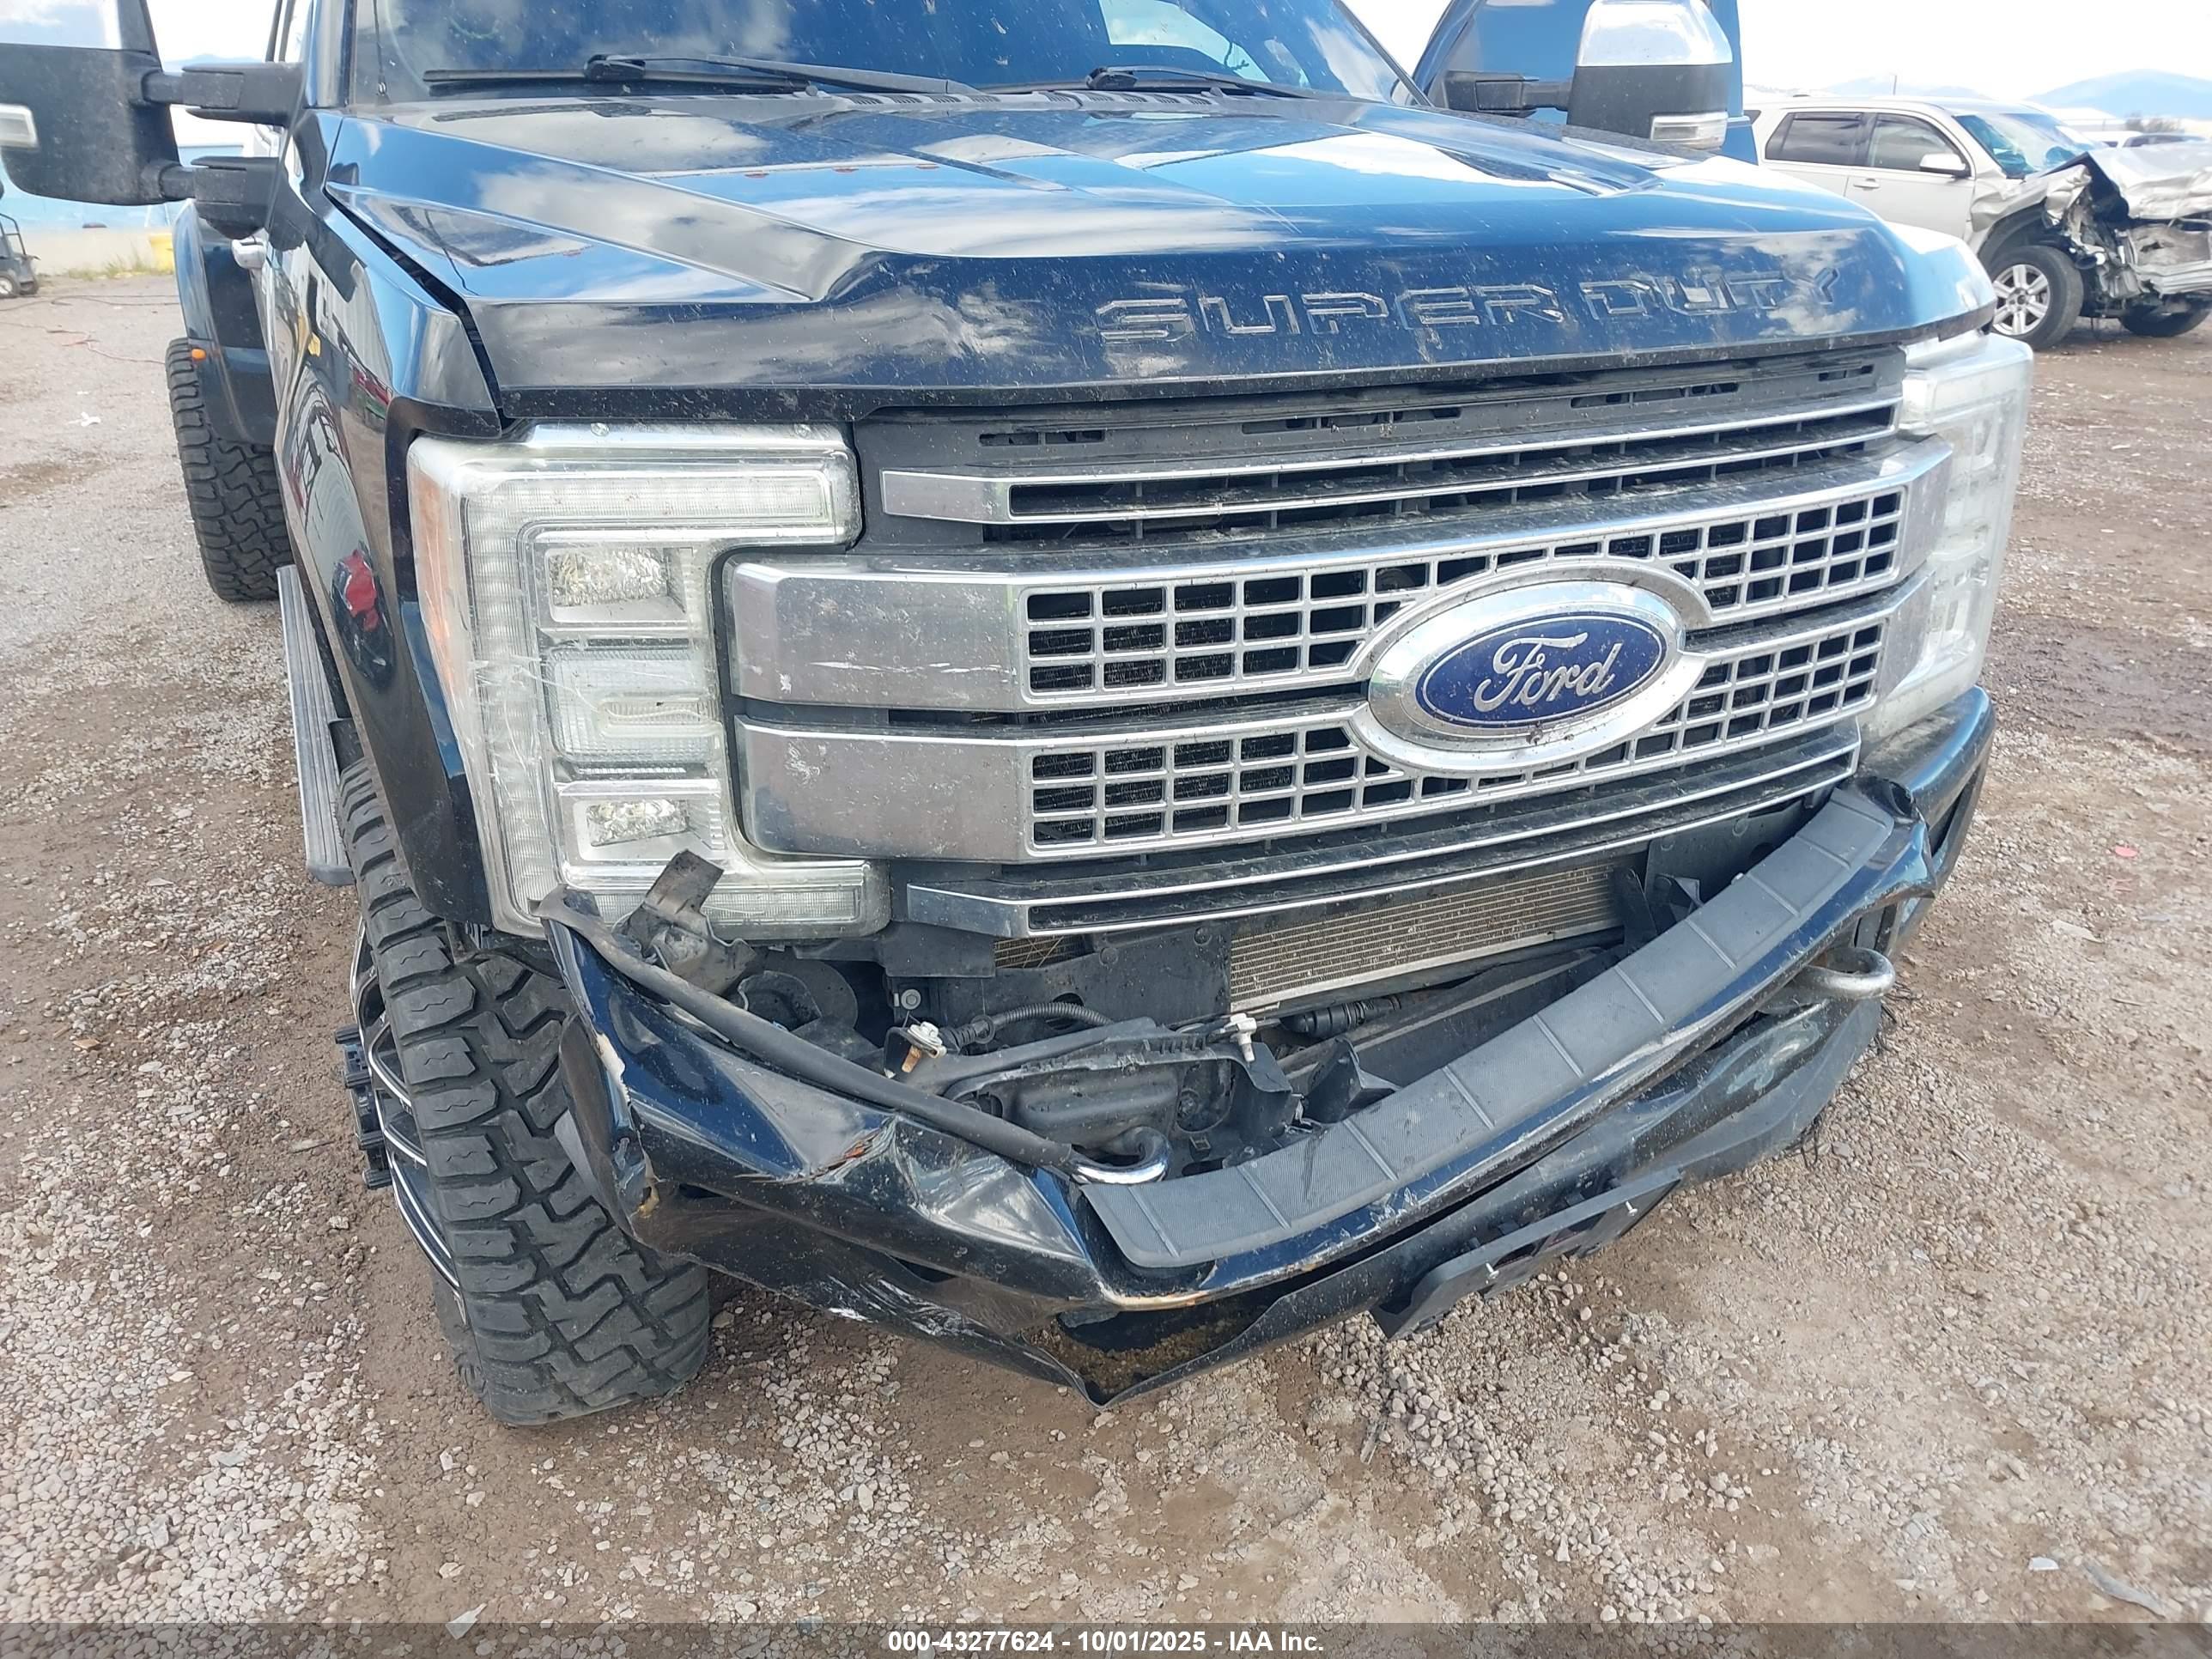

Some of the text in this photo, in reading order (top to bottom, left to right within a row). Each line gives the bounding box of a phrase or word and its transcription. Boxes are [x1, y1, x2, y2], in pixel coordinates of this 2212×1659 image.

[1095, 266, 1841, 343] SUPER DUTY
[1473, 631, 1623, 713] Ford
